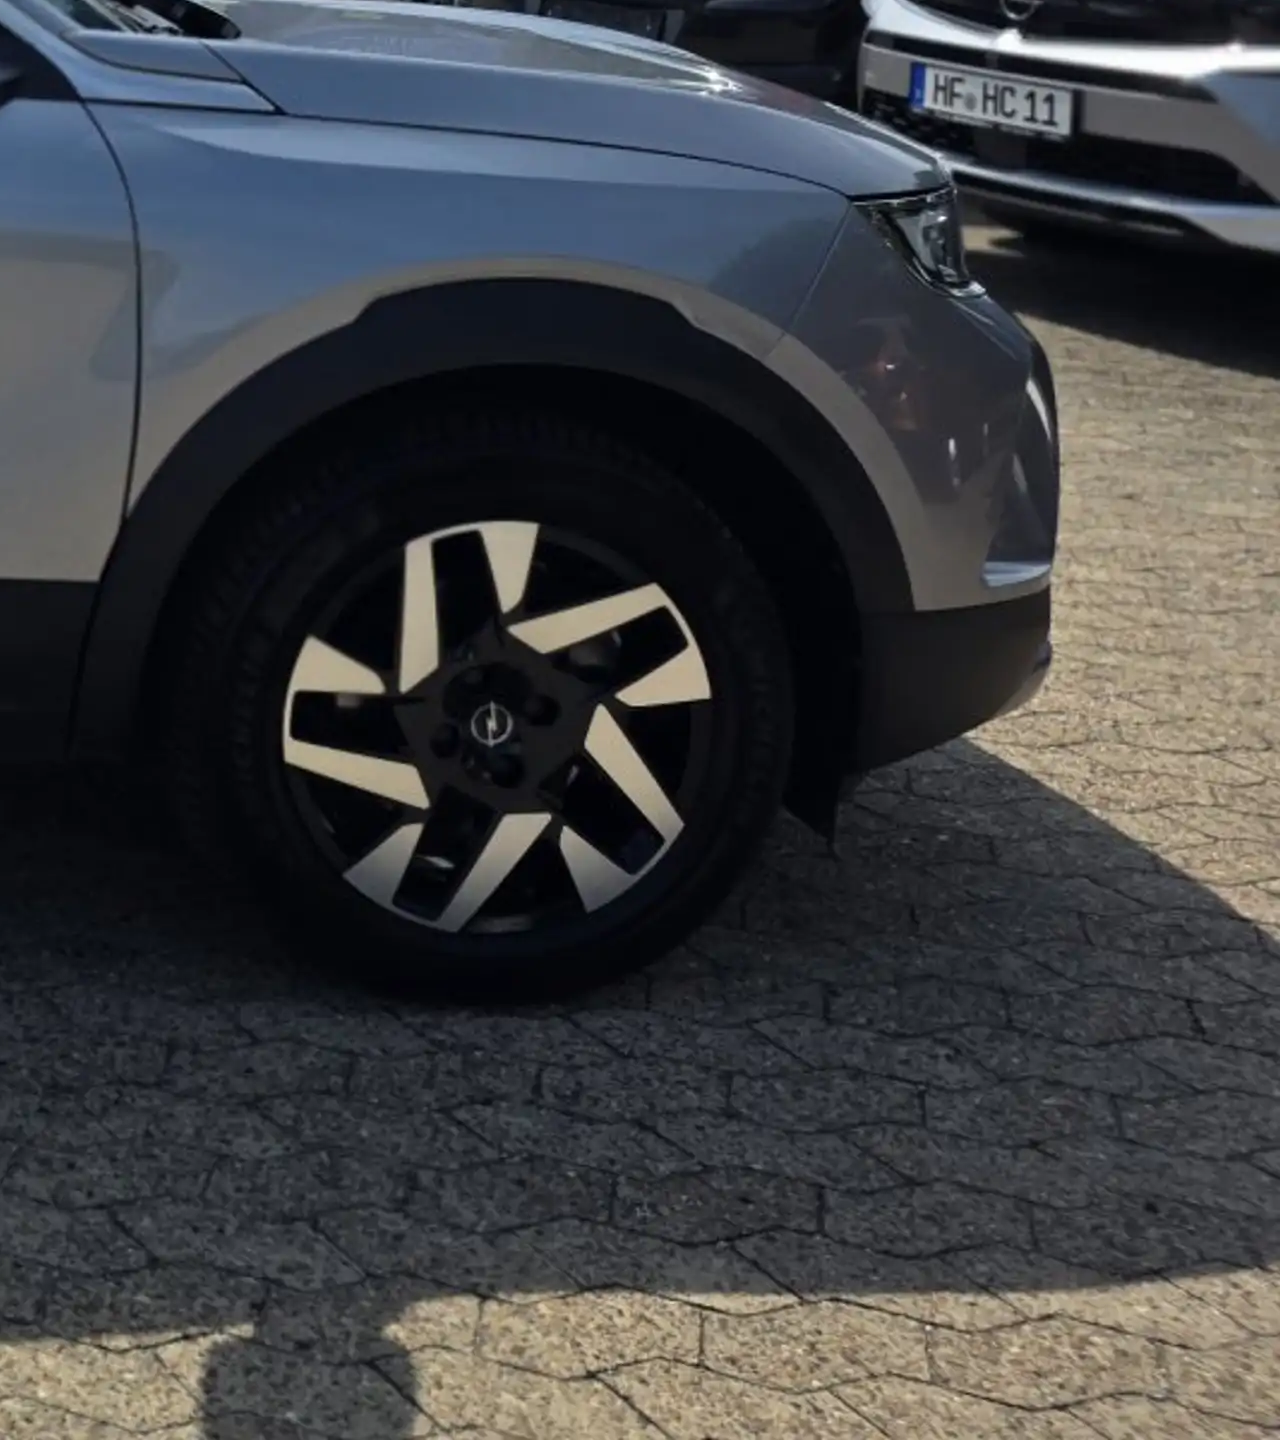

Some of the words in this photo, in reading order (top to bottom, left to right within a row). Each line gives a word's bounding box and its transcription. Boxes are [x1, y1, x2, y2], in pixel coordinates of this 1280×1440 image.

[932, 73, 966, 108] HF
[981, 81, 1018, 119] HC
[1022, 90, 1060, 128] 11
